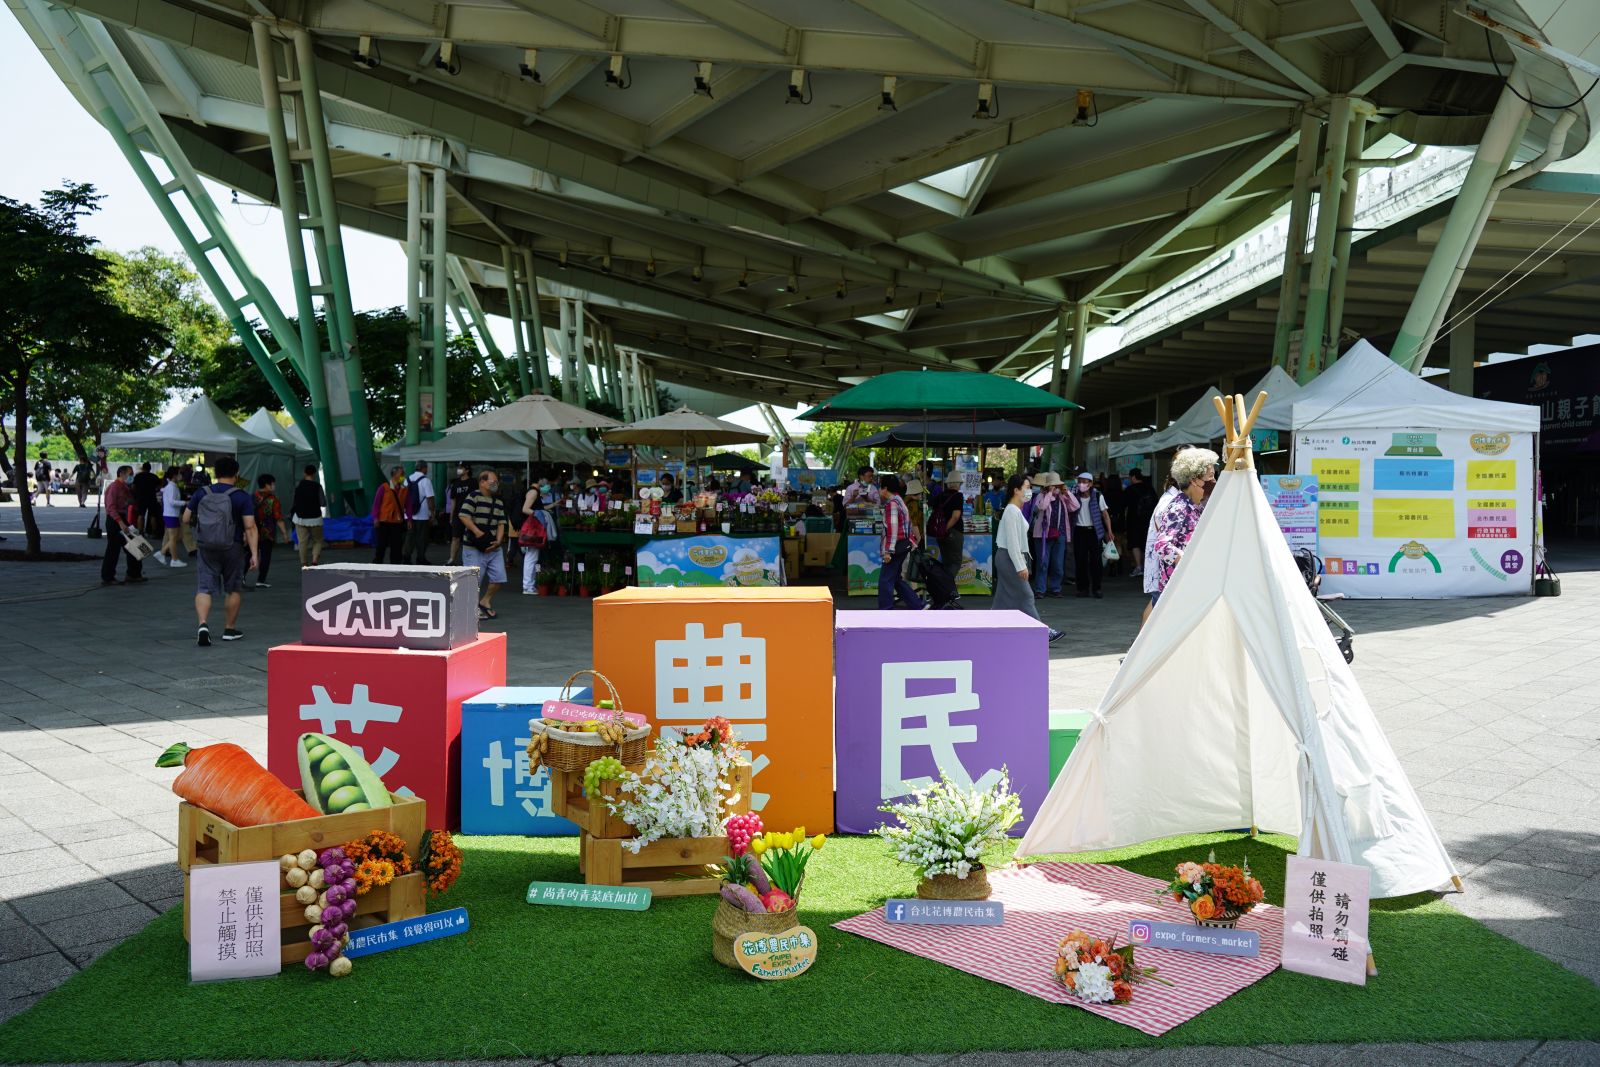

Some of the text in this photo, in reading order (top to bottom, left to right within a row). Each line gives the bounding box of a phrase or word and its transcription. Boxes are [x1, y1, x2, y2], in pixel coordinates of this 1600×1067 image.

[308, 584, 445, 635] TAIPEI
[881, 660, 1005, 800] 民
[245, 886, 264, 958] 僅供拍照
[911, 905, 995, 918] 台北花博農民市集
[1308, 870, 1328, 940] 僅供拍照
[217, 888, 237, 961] 禁止觸摸
[403, 917, 454, 938] 我覺得可以
[1155, 931, 1252, 948] expo_farmers_market
[1331, 892, 1351, 962] 請勿觸碰
[742, 932, 811, 956] 花博農民市集
[768, 953, 791, 961] TAIPEI
[772, 960, 792, 968] EXPO
